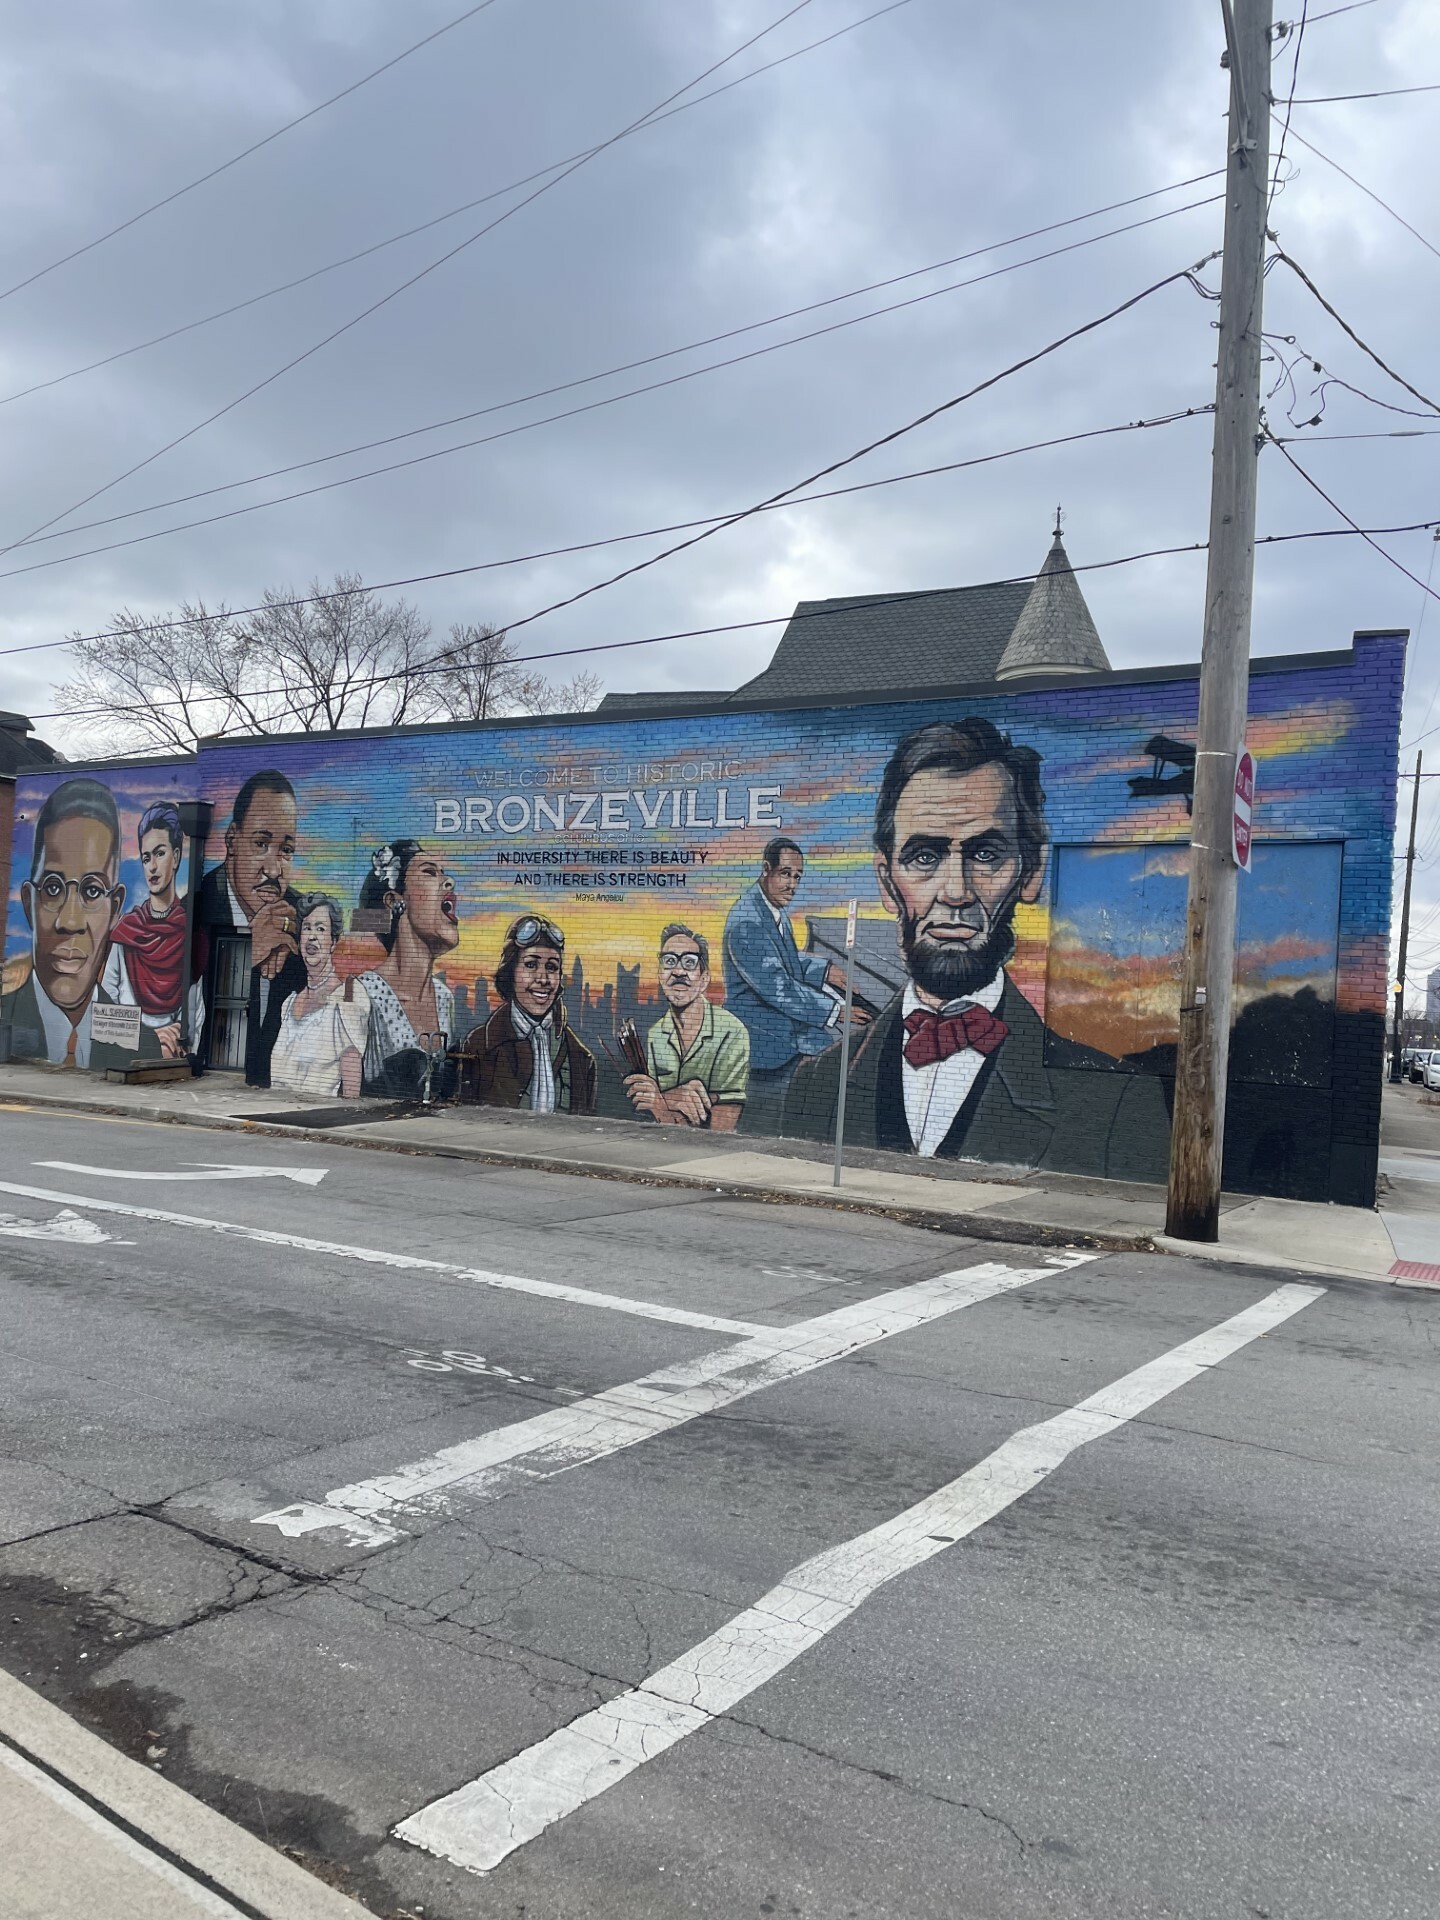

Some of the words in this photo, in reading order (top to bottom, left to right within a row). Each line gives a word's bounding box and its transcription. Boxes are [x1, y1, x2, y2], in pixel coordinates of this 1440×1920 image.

[474, 767, 583, 788] WELCOME
[589, 766, 619, 785] TO
[626, 760, 743, 783] HISTORIC
[433, 784, 782, 834] BRONZEVILLE
[497, 851, 510, 864] IN
[513, 851, 580, 864] DIVERSITY
[584, 850, 628, 864] THERE
[633, 851, 645, 864] IS
[650, 850, 709, 864] BEAUTY
[514, 873, 542, 886] AND
[545, 872, 589, 886] THERE
[593, 872, 605, 885] IS
[609, 872, 687, 887] STRENGTH
